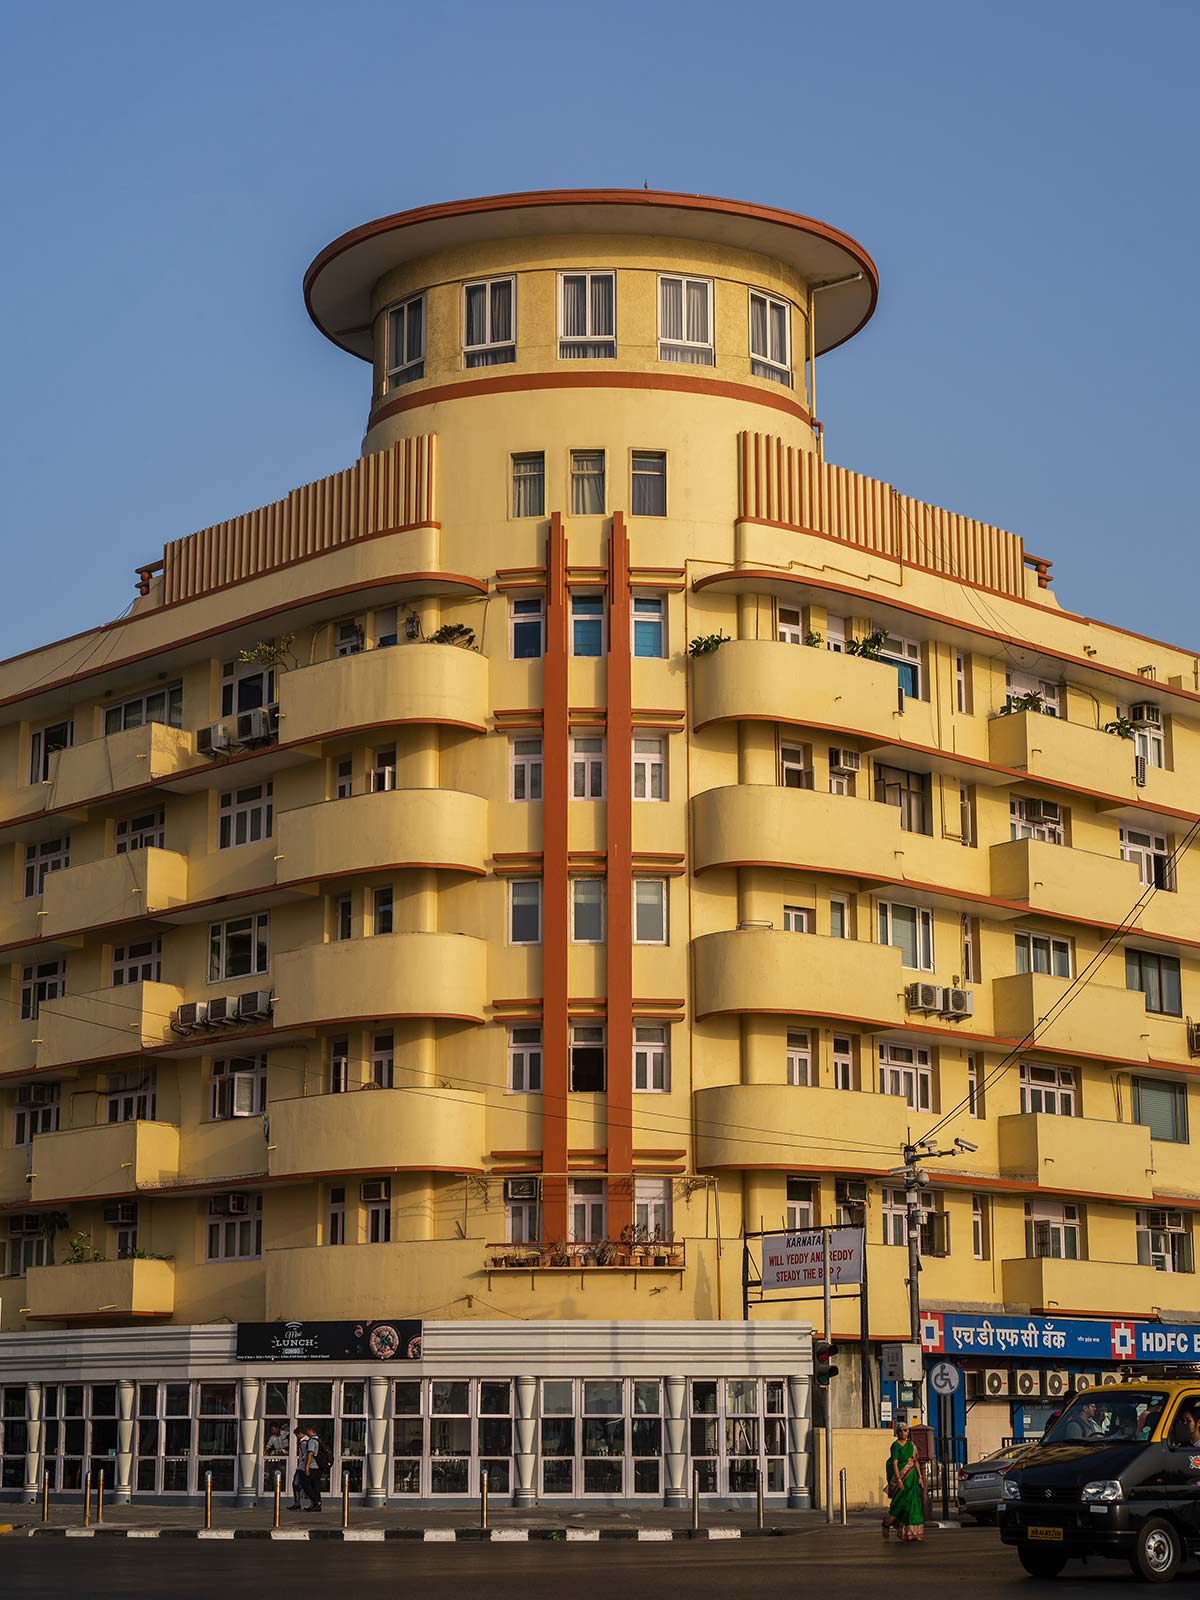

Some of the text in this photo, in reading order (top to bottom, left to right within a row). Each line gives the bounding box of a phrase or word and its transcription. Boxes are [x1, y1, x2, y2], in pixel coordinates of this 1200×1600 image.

[768, 1256, 784, 1267] WILL
[786, 1252, 809, 1265] YEDDY
[829, 1249, 854, 1262] REDDY
[775, 1269, 801, 1282] STEADY
[802, 1268, 816, 1280] THE
[818, 1267, 834, 1278] BP
[275, 1339, 314, 1347] LUNCH
[1142, 1332, 1188, 1353] HDFC
